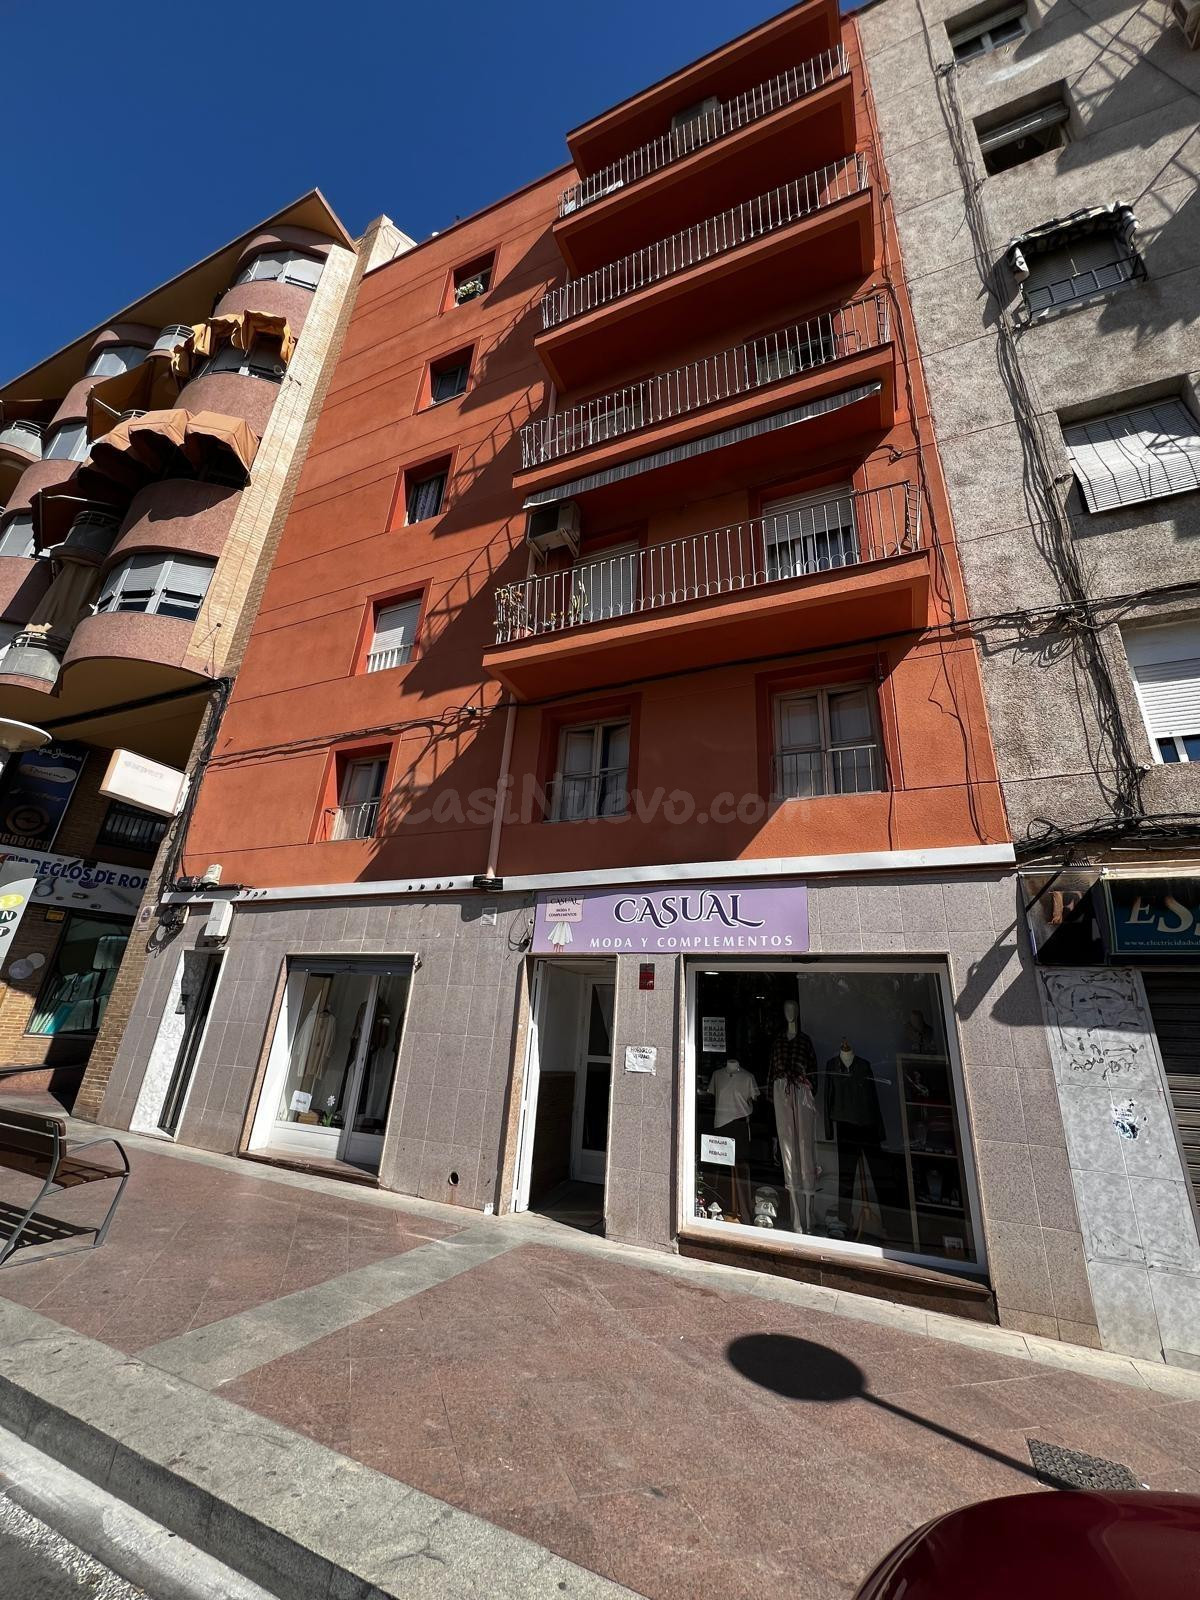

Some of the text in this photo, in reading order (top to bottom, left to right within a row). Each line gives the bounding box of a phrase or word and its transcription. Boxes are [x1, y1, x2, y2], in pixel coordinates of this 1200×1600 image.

[7, 855, 92, 881] REGLOS
[94, 870, 117, 885] DE
[614, 889, 765, 928] CASUAL
[590, 935, 793, 948] MODA Y COMPLEMENTOS
